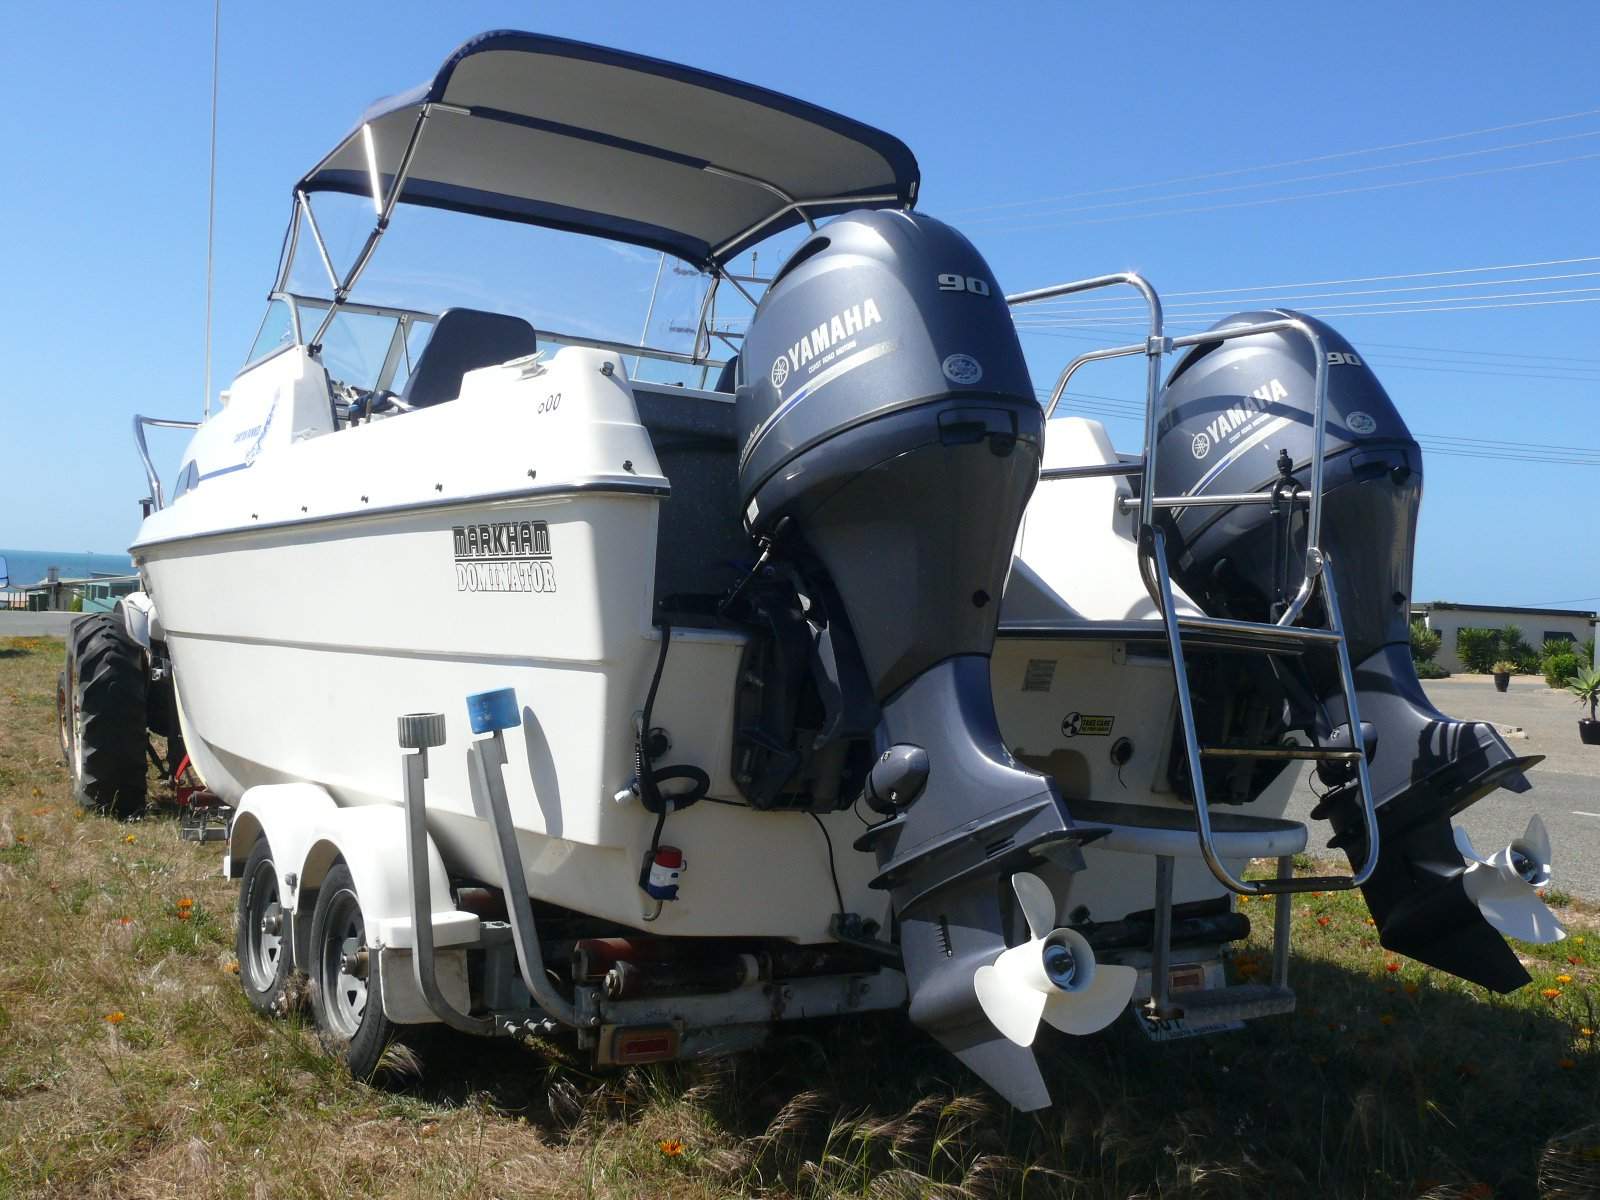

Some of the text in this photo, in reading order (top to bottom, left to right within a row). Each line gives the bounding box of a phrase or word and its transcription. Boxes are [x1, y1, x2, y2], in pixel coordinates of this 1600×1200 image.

[938, 274, 989, 296] 90
[788, 298, 882, 372] YAMAHA
[1327, 352, 1361, 366] 90
[1206, 379, 1288, 444] YAMAHA
[453, 520, 551, 557] MARKHAM
[456, 561, 556, 592] DOMINATOR
